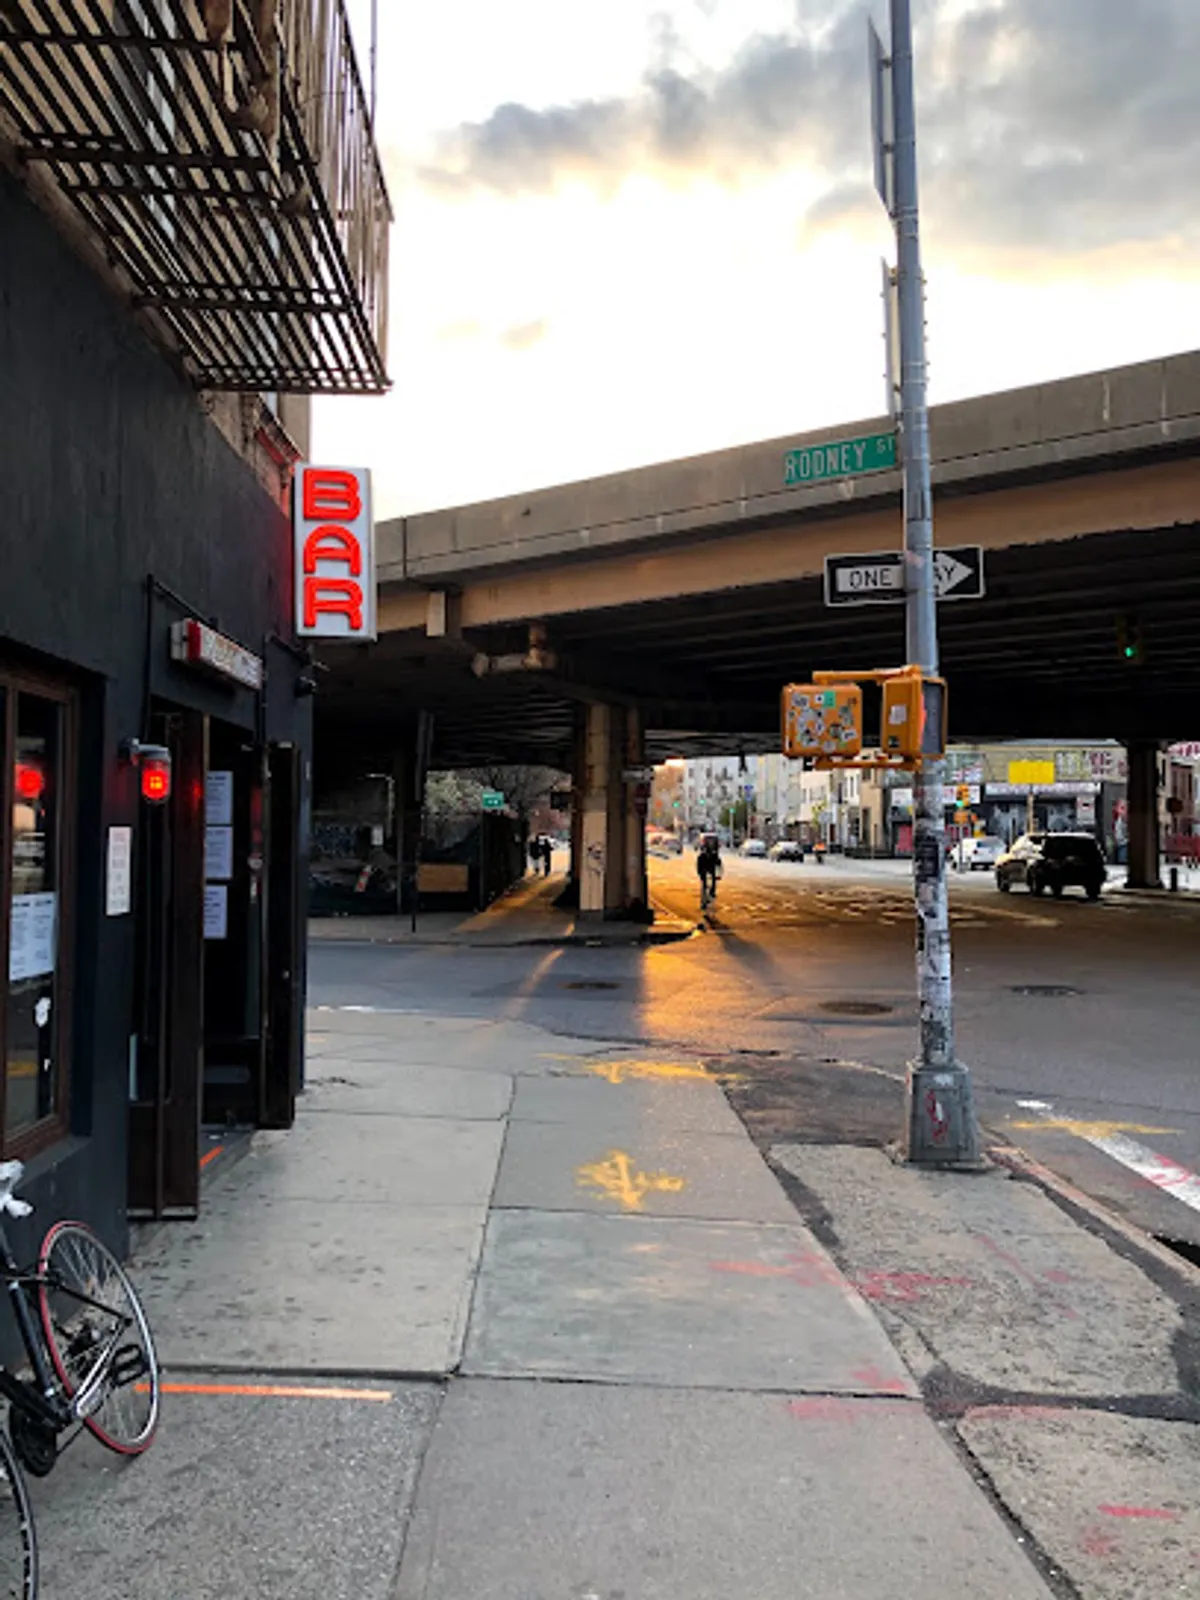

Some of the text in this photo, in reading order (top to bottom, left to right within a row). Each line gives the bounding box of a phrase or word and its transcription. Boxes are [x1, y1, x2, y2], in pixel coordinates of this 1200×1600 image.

[784, 437, 894, 480] RODNEY ST
[303, 468, 363, 630] BAR
[849, 568, 893, 589] ONE
